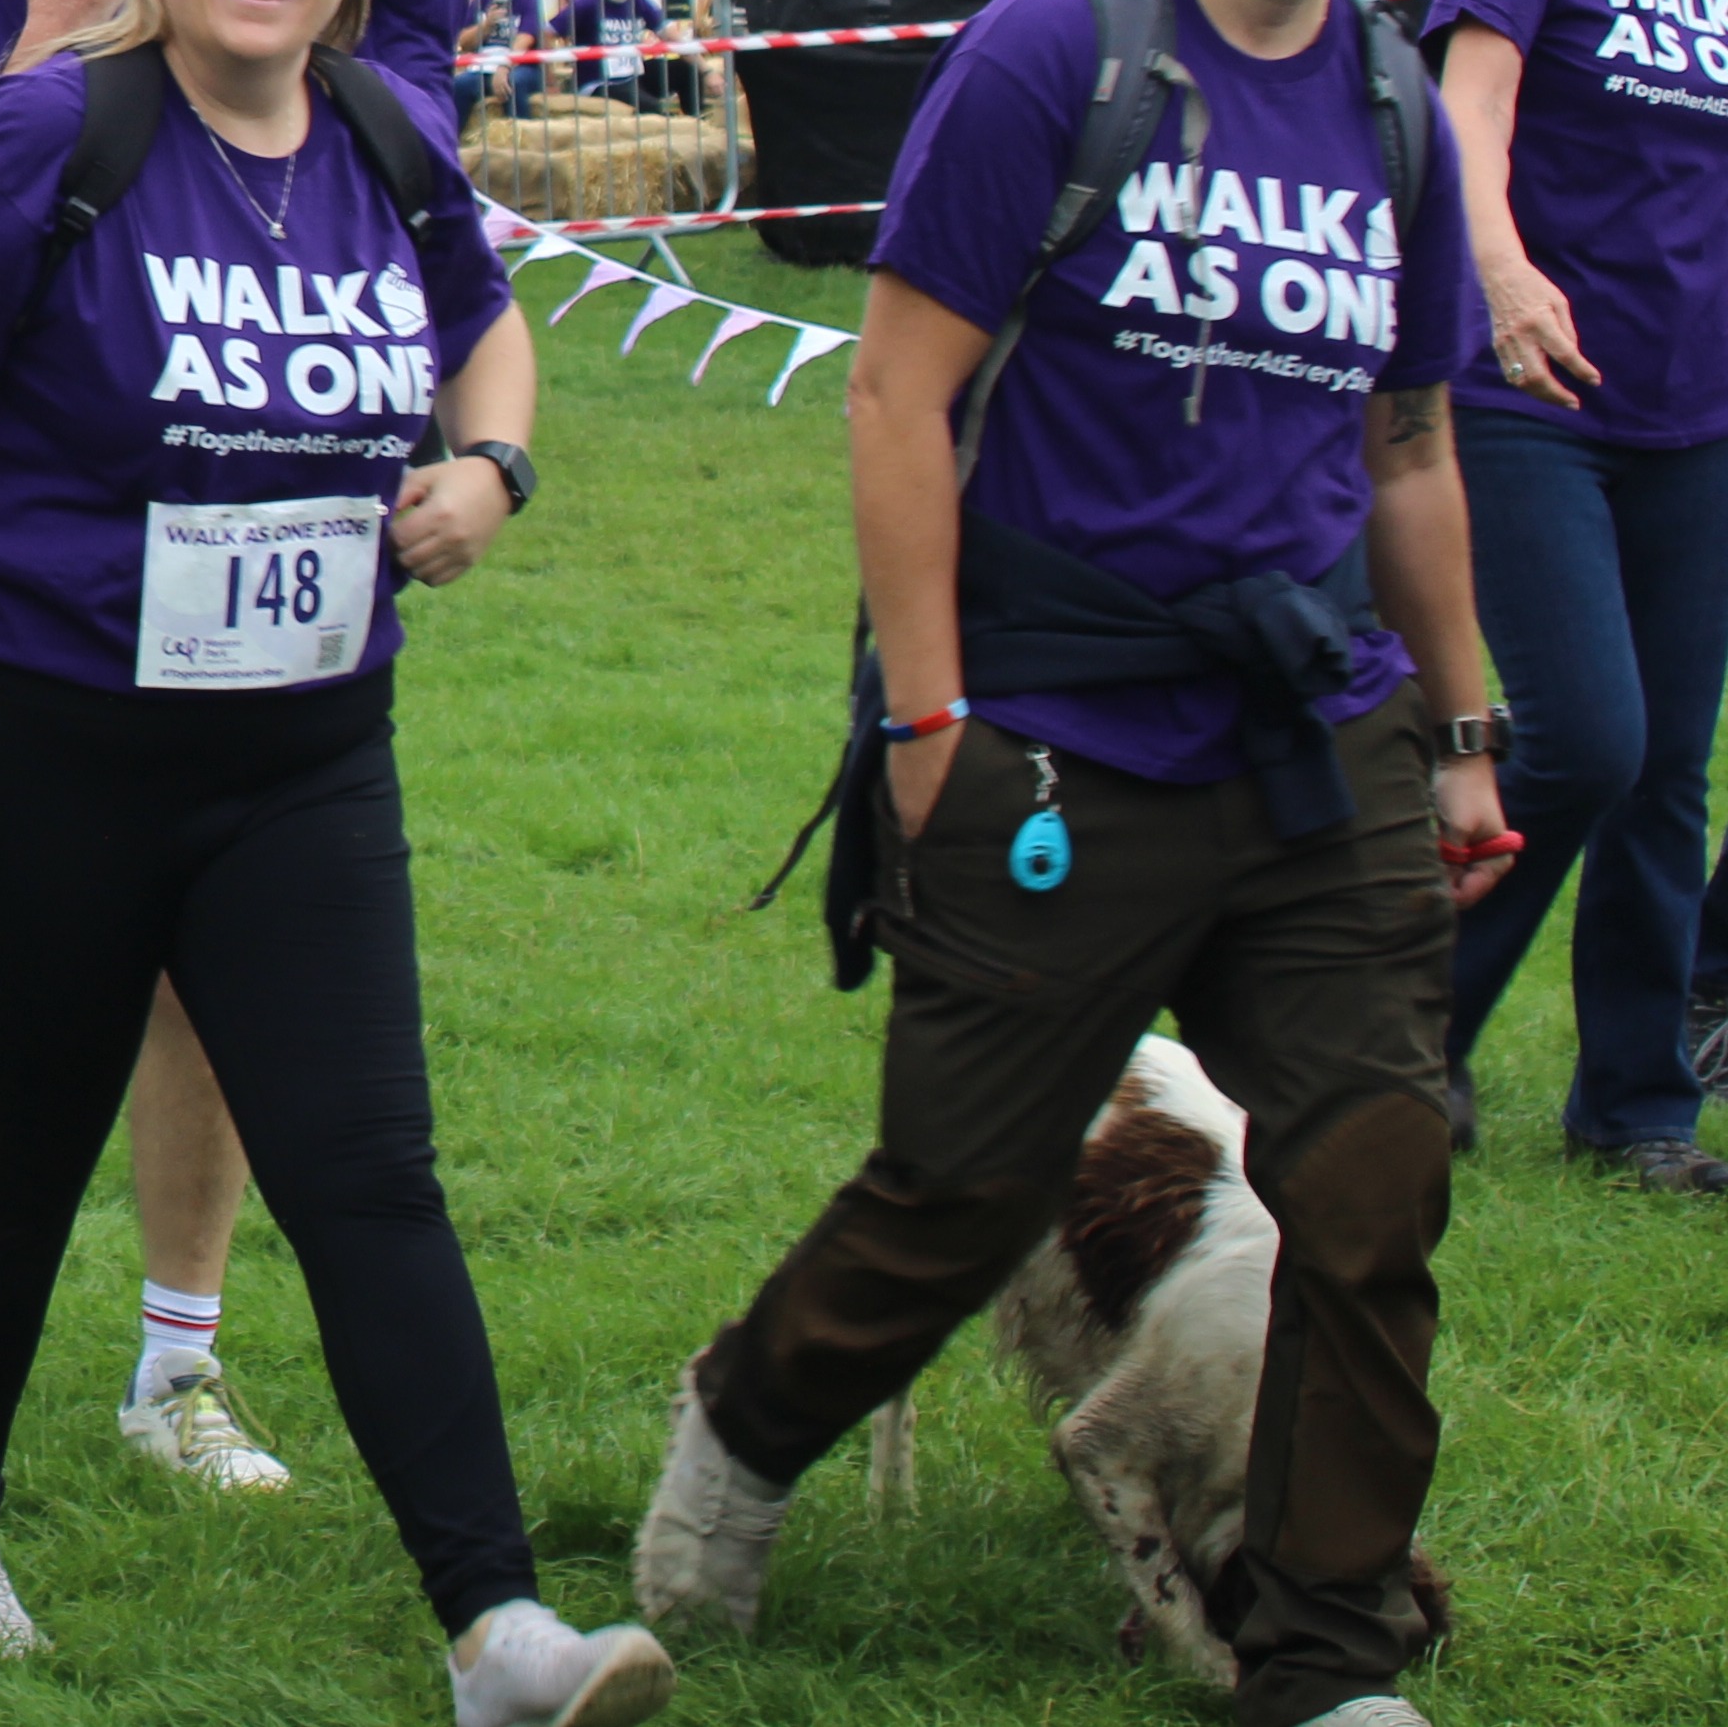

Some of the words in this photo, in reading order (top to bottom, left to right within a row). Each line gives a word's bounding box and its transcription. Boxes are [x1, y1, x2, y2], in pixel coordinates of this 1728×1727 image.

[1596, 13, 1690, 73] AS
[1117, 160, 1363, 262] WALK
[144, 252, 390, 338] WALK
[1100, 240, 1239, 321] AS
[1260, 258, 1398, 352] ONE
[150, 333, 270, 410] AS
[286, 342, 436, 417] ONE
[165, 525, 240, 546] WALK
[243, 526, 269, 544] AS
[273, 522, 316, 541] ONE
[319, 518, 369, 539] 2026
[224, 549, 321, 629] 148
